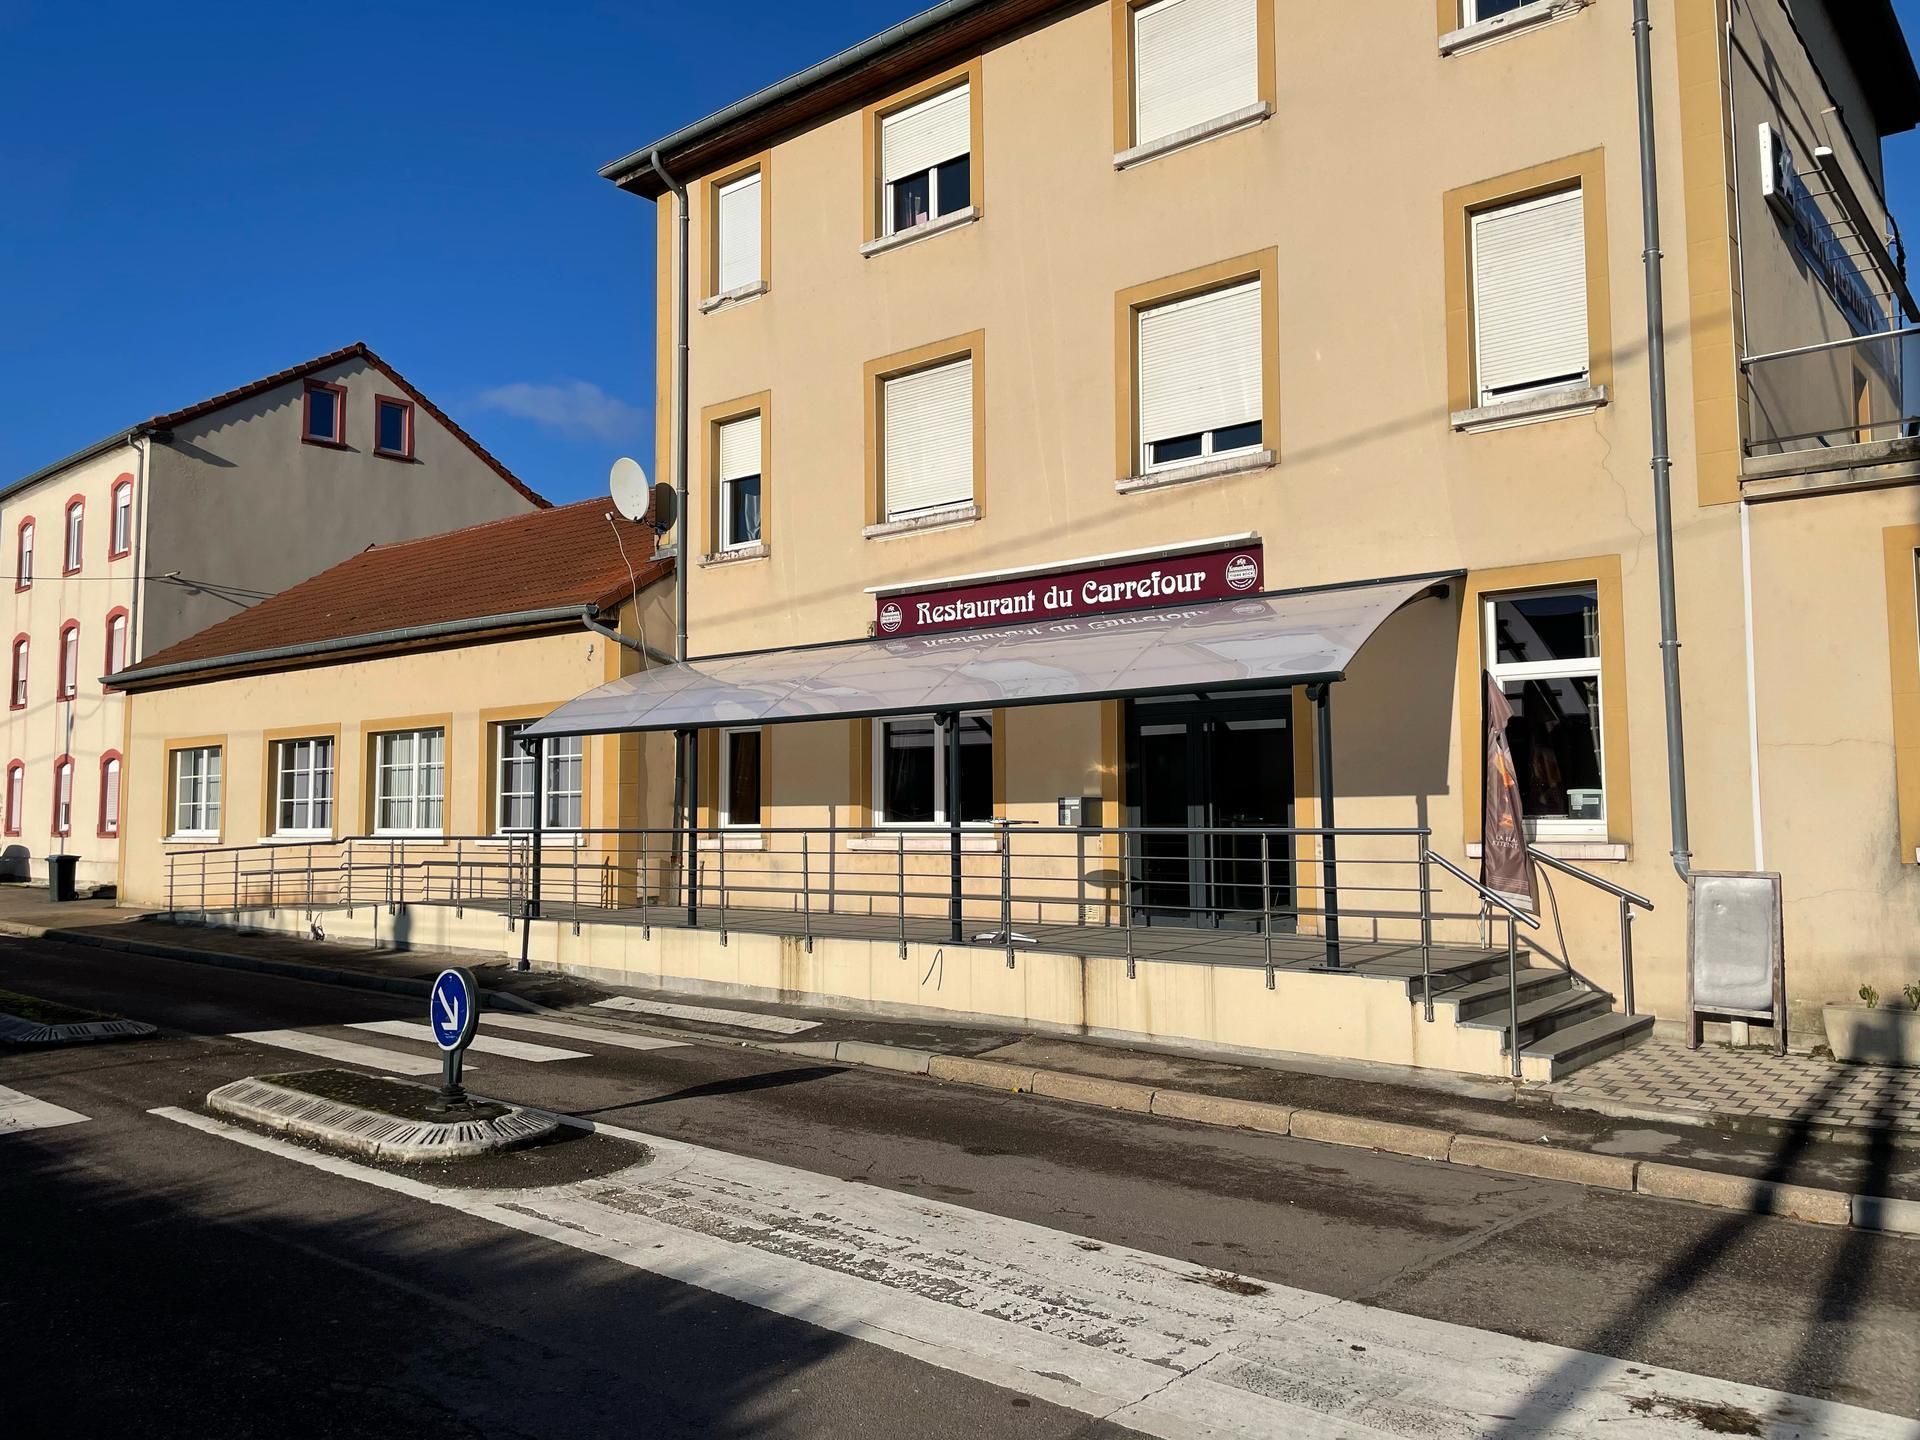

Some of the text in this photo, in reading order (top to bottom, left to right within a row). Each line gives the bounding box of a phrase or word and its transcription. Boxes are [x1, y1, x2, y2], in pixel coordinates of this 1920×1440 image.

[916, 570, 1207, 625] Restaurant du Carrefour
